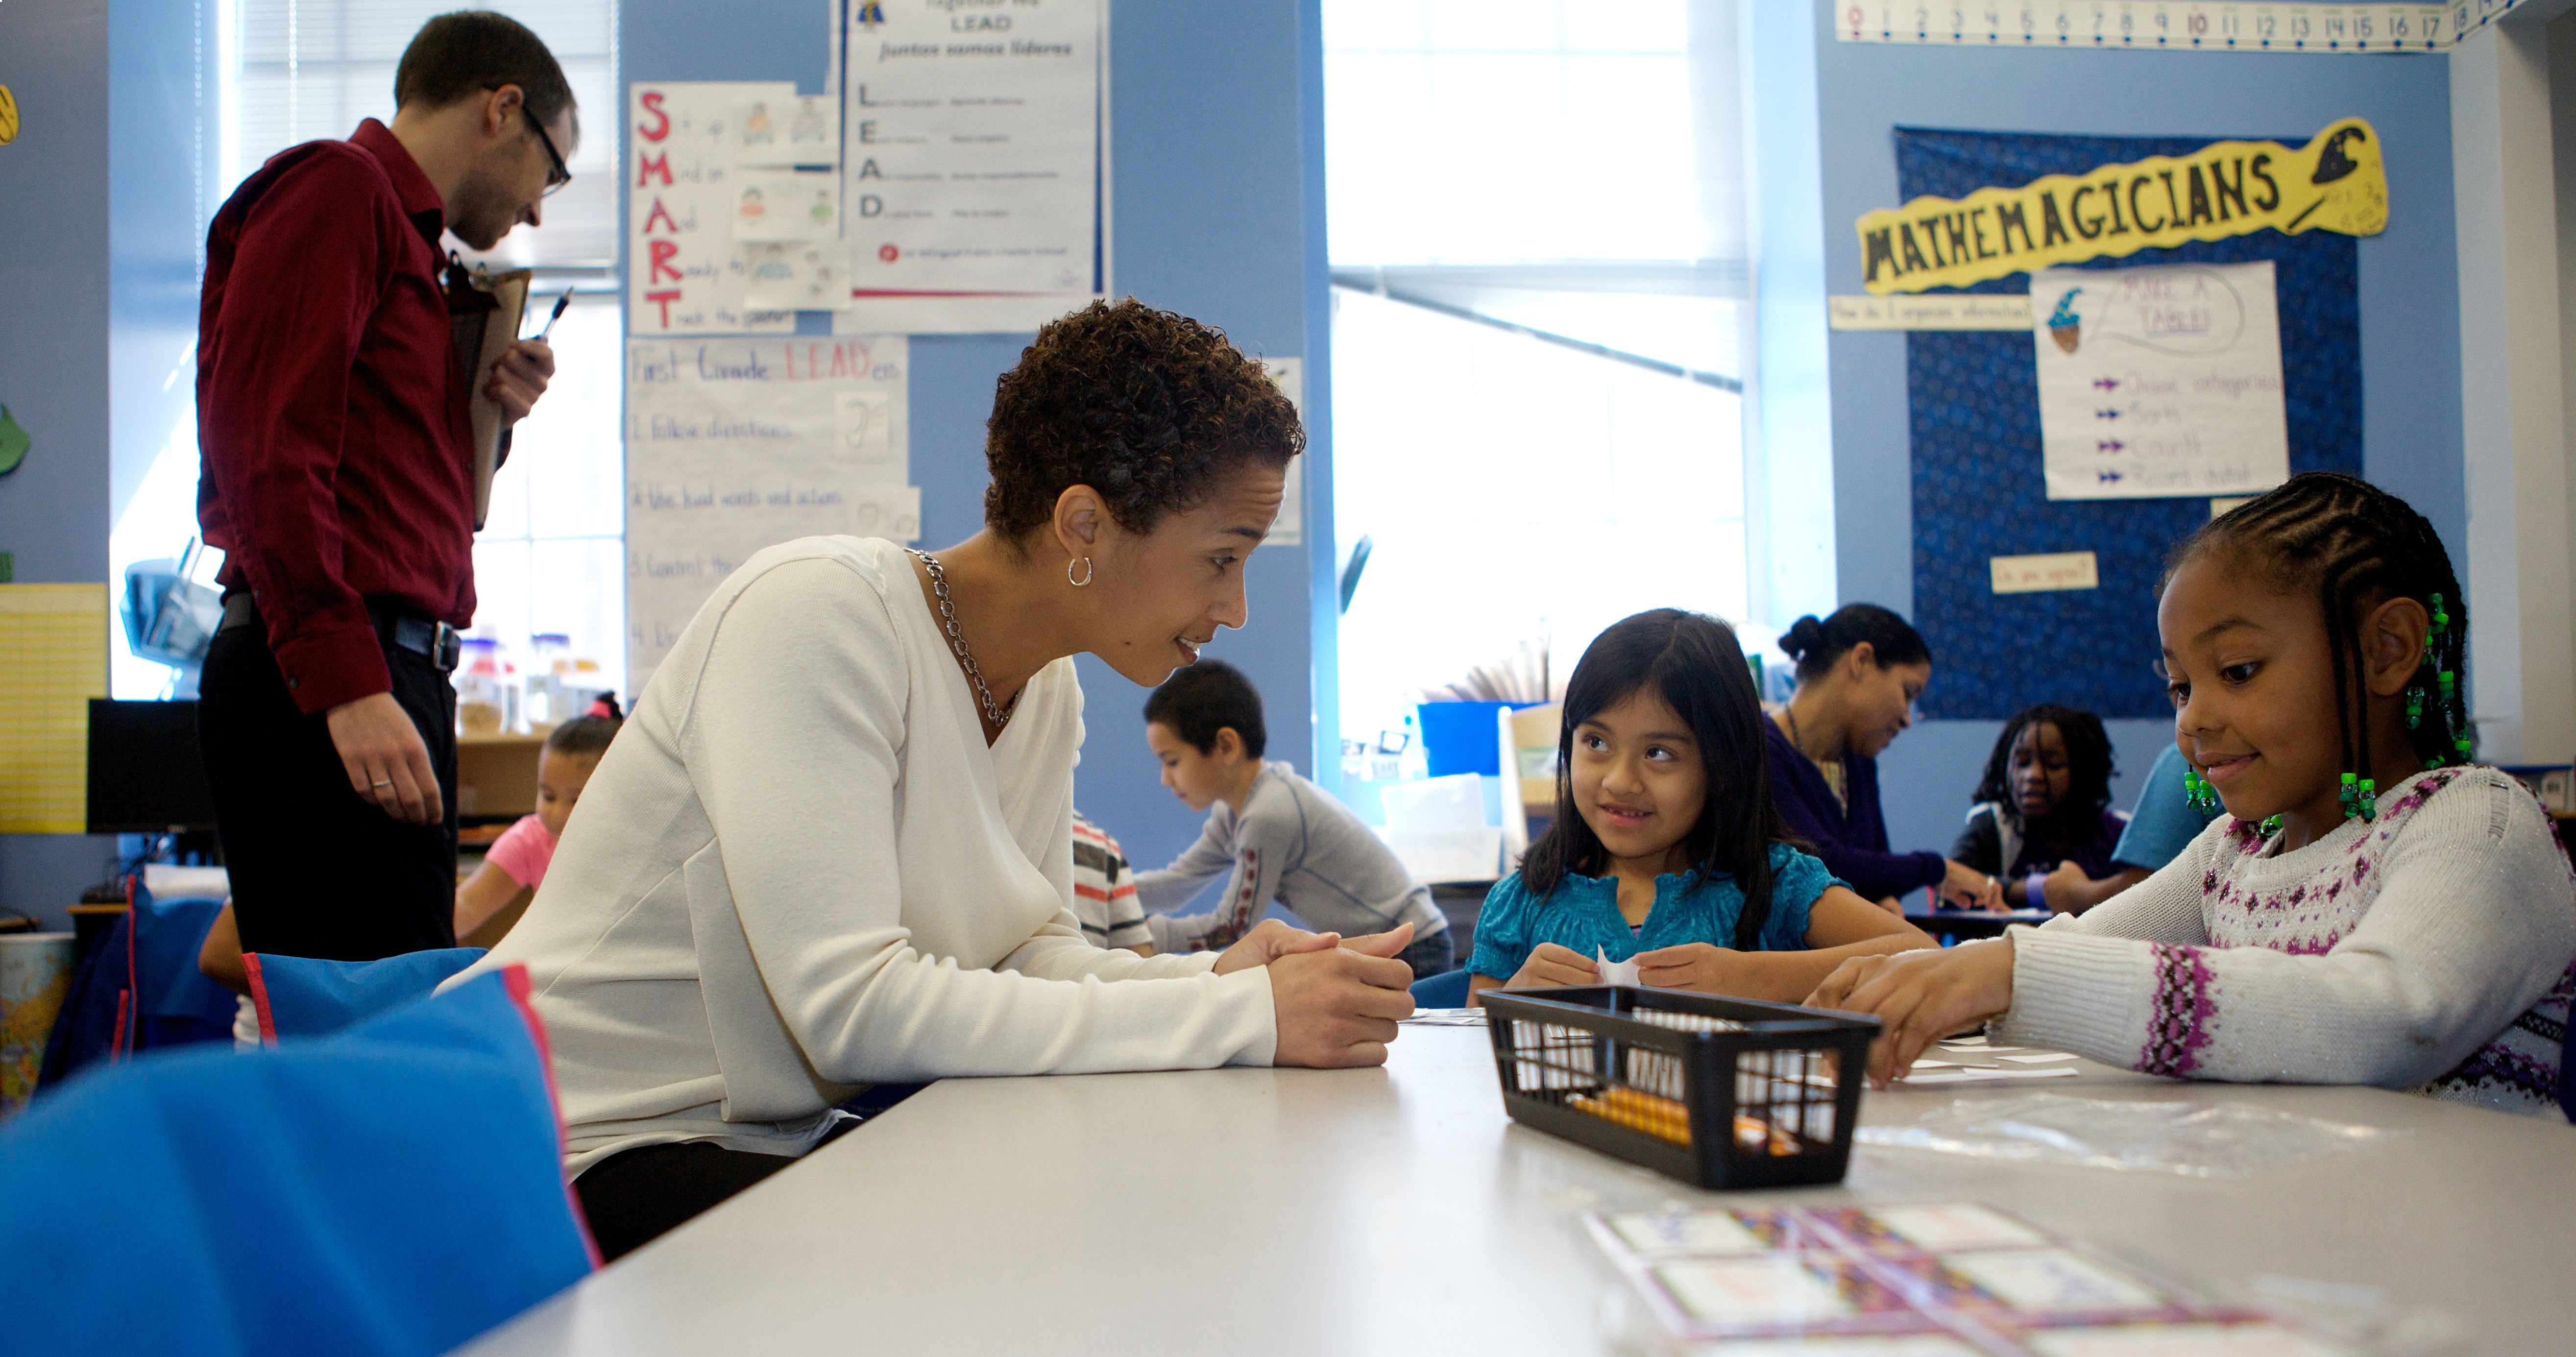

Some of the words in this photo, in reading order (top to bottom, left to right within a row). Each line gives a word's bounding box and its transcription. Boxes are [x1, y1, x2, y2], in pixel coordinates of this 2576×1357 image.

[951, 15, 1012, 31] LEAD
[1915, 8, 1929, 28] 2
[1950, 8, 1964, 29] 3
[1985, 9, 1999, 31] 4
[2021, 9, 2036, 31] 5
[2056, 12, 2070, 32] 6
[2093, 12, 2106, 31] 7
[2121, 13, 2133, 32] 8
[2155, 13, 2168, 33] 9
[2187, 14, 2209, 35] 10
[2222, 15, 2239, 35] 11
[2257, 15, 2276, 37] 12
[2291, 16, 2310, 37] 13
[2325, 16, 2345, 38] 14
[2353, 16, 2374, 38] 15
[2389, 16, 2408, 37] 16
[2422, 16, 2440, 38] 17
[1865, 153, 2280, 282] MATHEMAGICIANS
